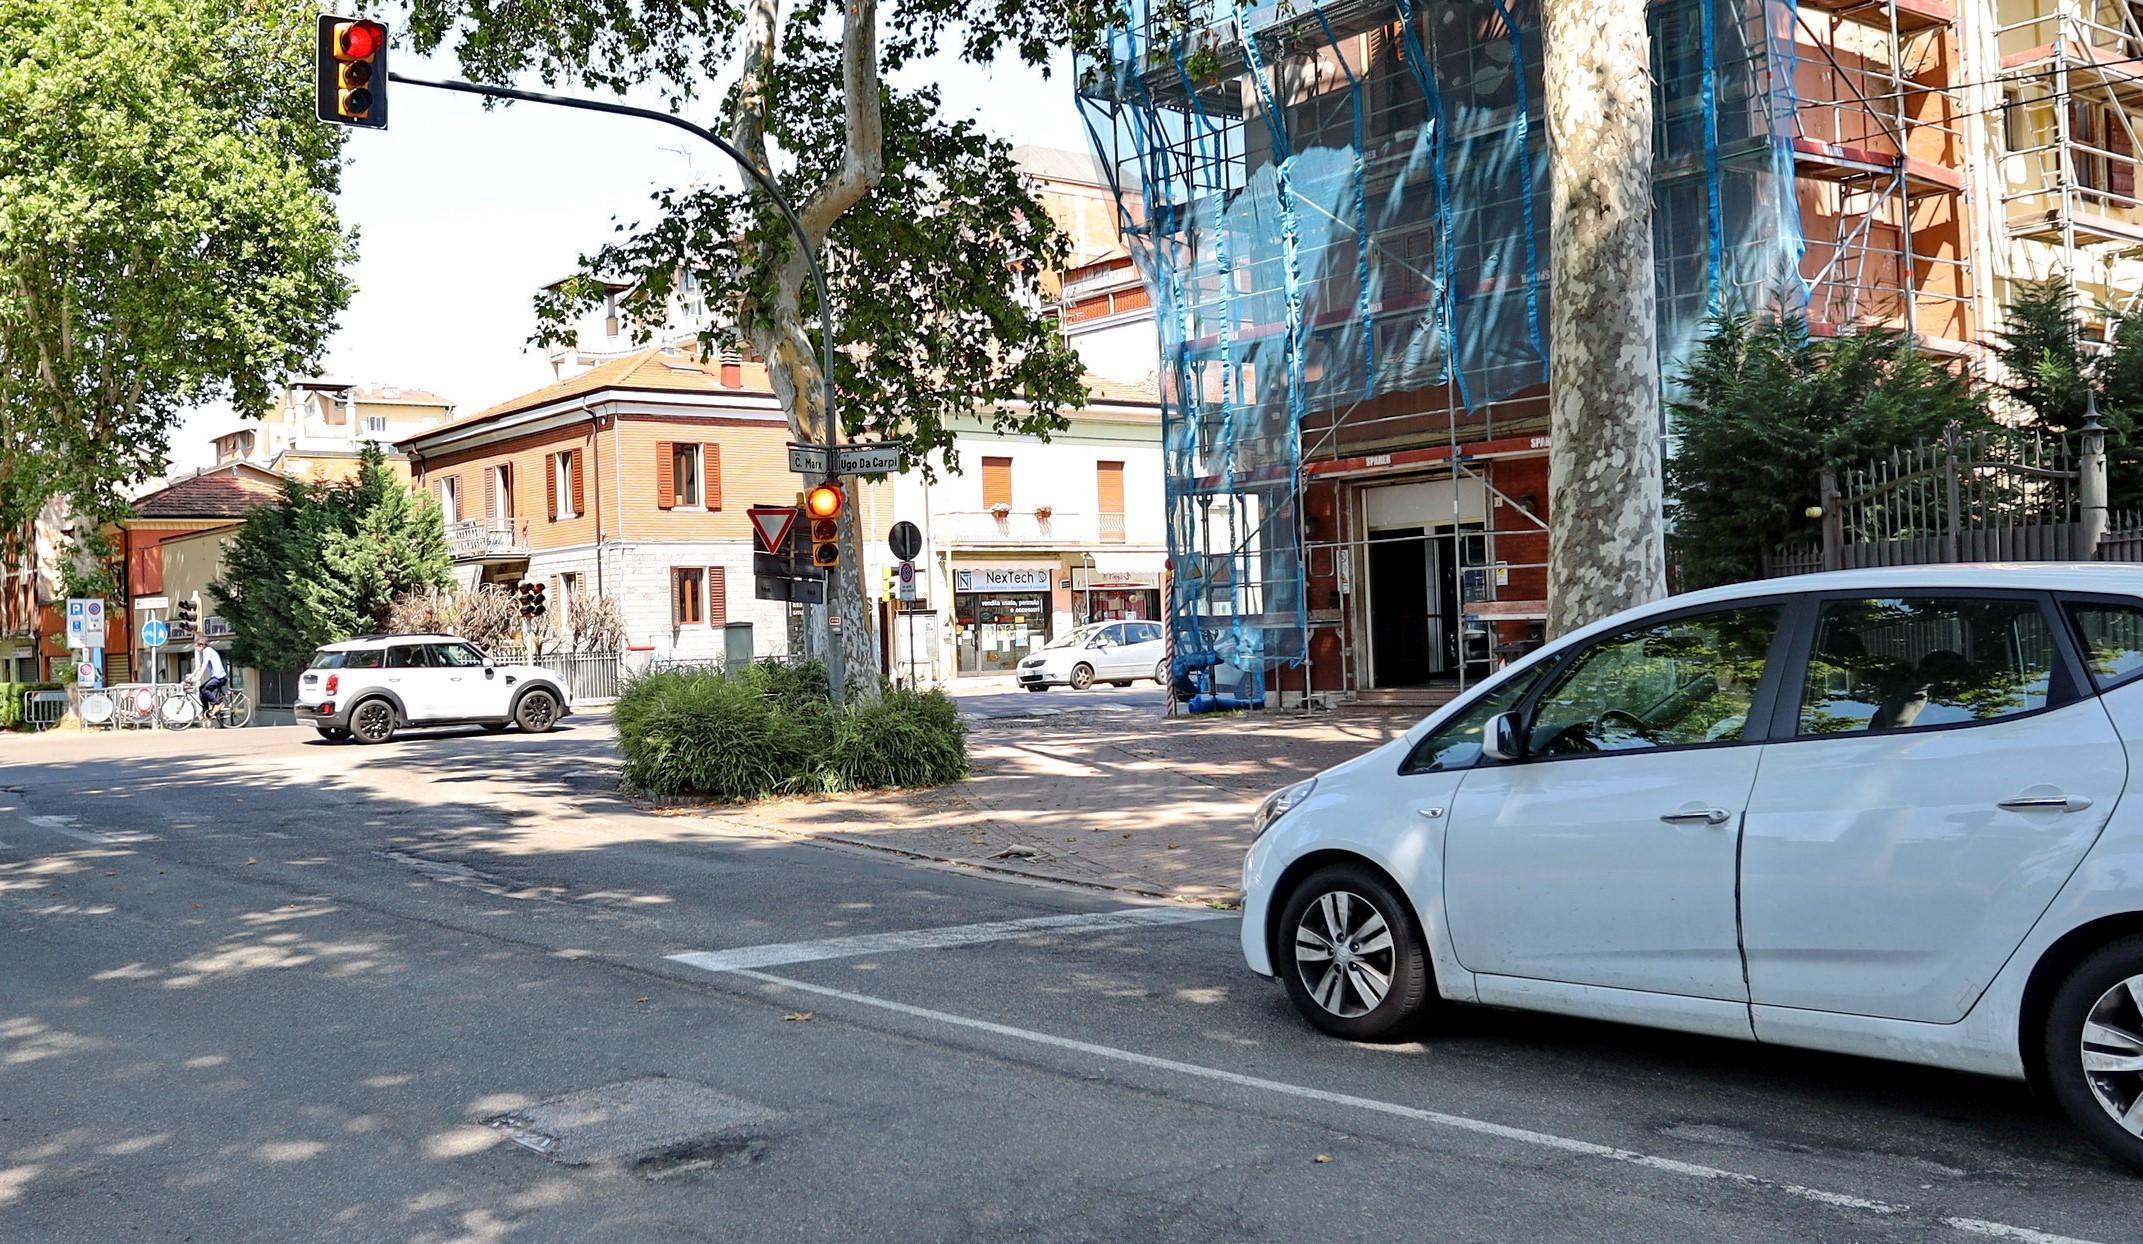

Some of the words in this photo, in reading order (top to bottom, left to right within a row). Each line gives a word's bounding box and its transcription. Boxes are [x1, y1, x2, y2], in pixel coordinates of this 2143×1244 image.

[795, 457, 803, 468] C.
[805, 457, 822, 470] Marx
[840, 459, 858, 472] Ugo
[859, 457, 871, 469] Da
[872, 456, 898, 470] Carpi
[986, 571, 1035, 584] NexTech
